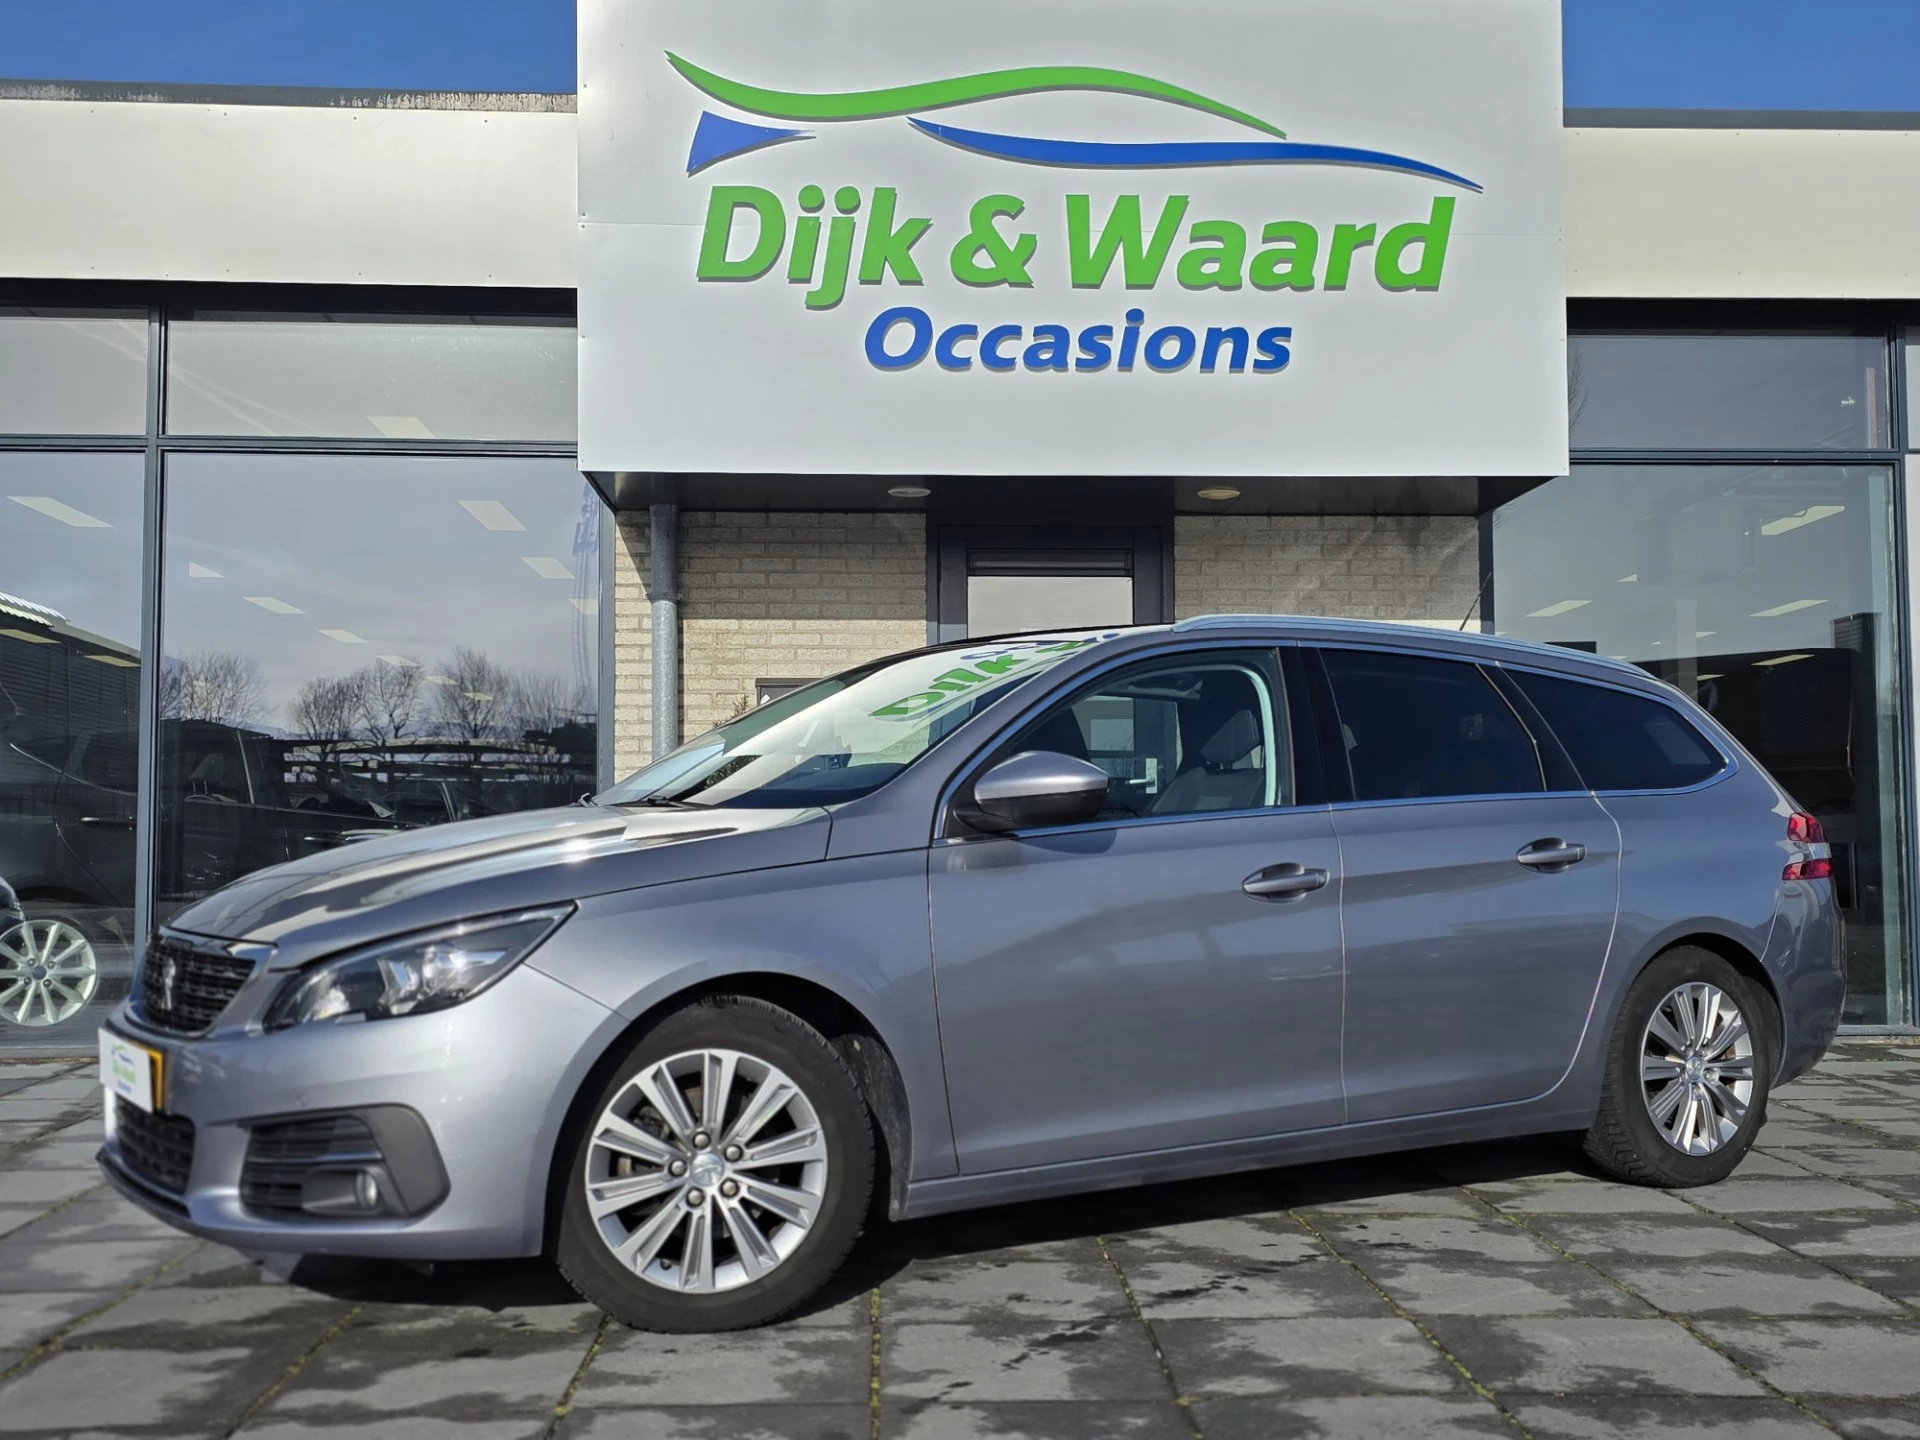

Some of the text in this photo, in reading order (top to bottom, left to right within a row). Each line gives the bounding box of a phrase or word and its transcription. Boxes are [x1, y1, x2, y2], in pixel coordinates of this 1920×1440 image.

[696, 185, 1457, 308] Dijk & Waard
[864, 306, 1293, 374] Occasions
